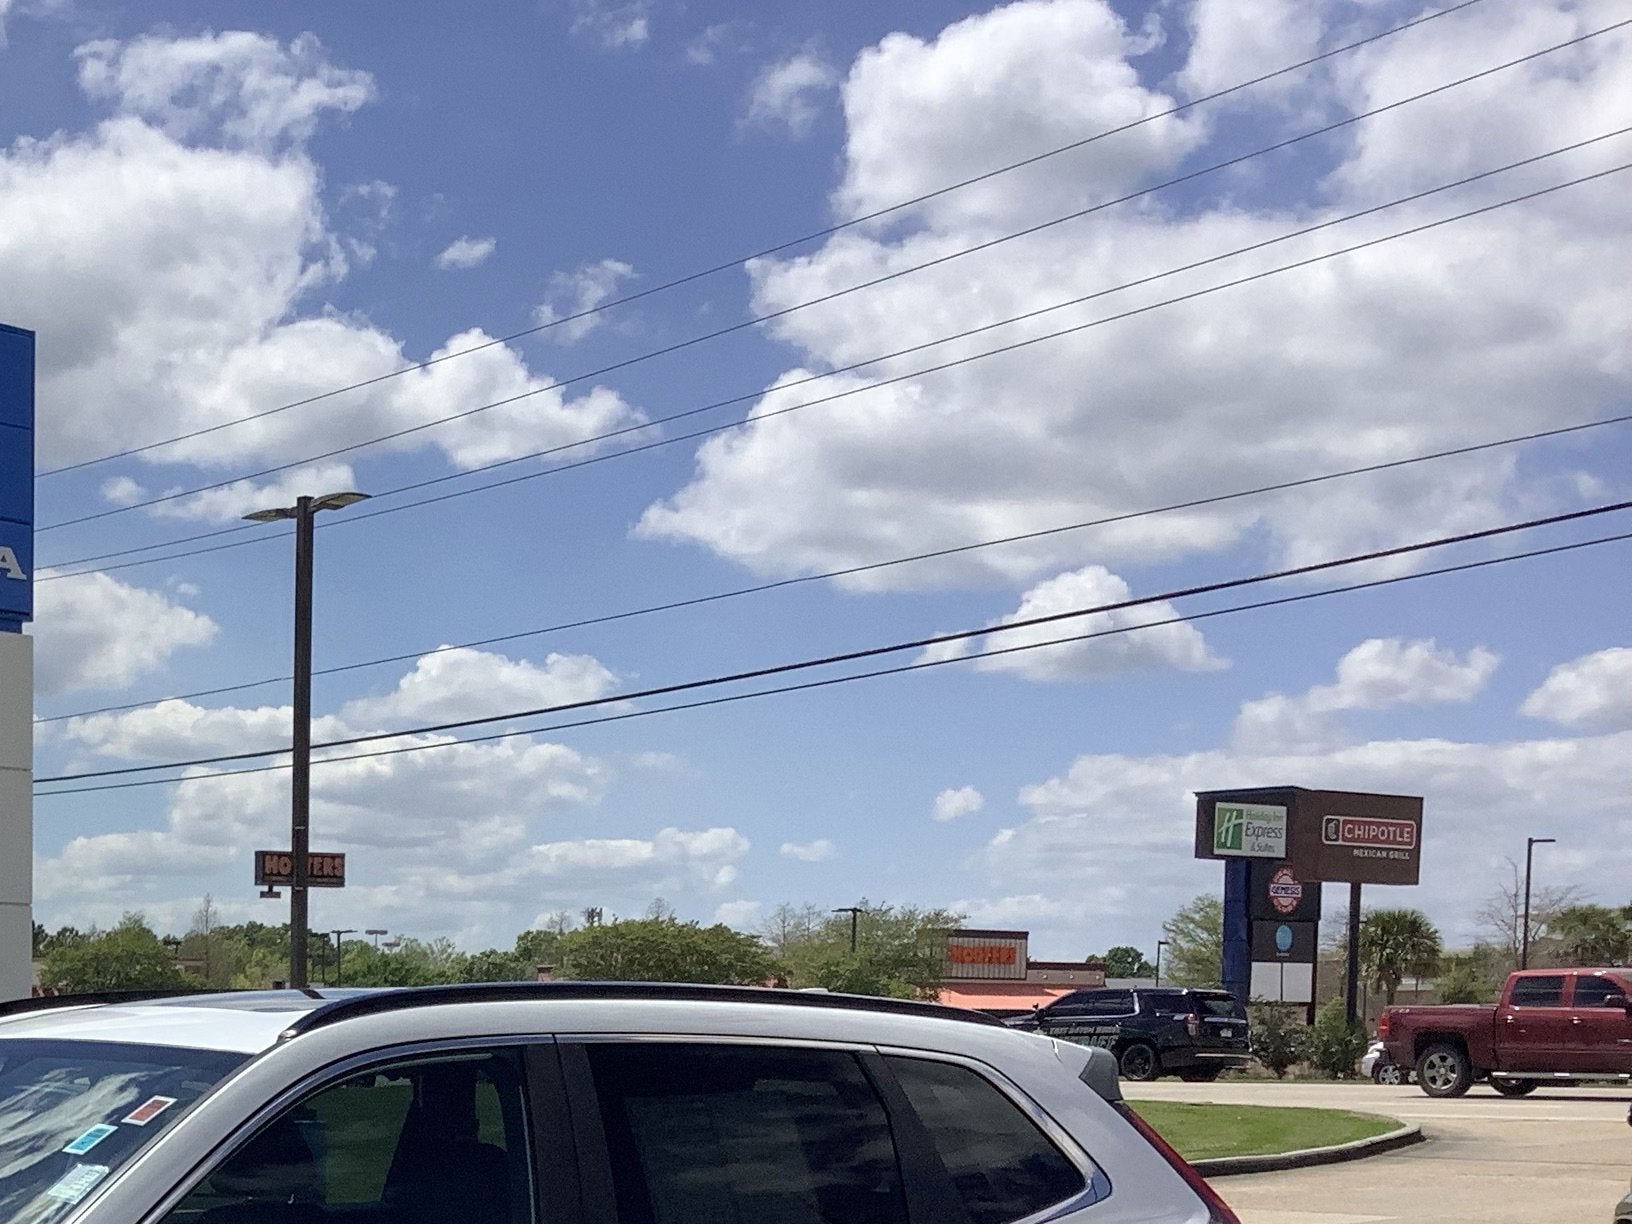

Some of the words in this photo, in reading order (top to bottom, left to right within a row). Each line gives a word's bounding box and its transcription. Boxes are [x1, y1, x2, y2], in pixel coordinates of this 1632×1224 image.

[1245, 821, 1283, 840] Express
[1344, 823, 1412, 842] CHIPOTLE
[264, 854, 344, 876] HOERS
